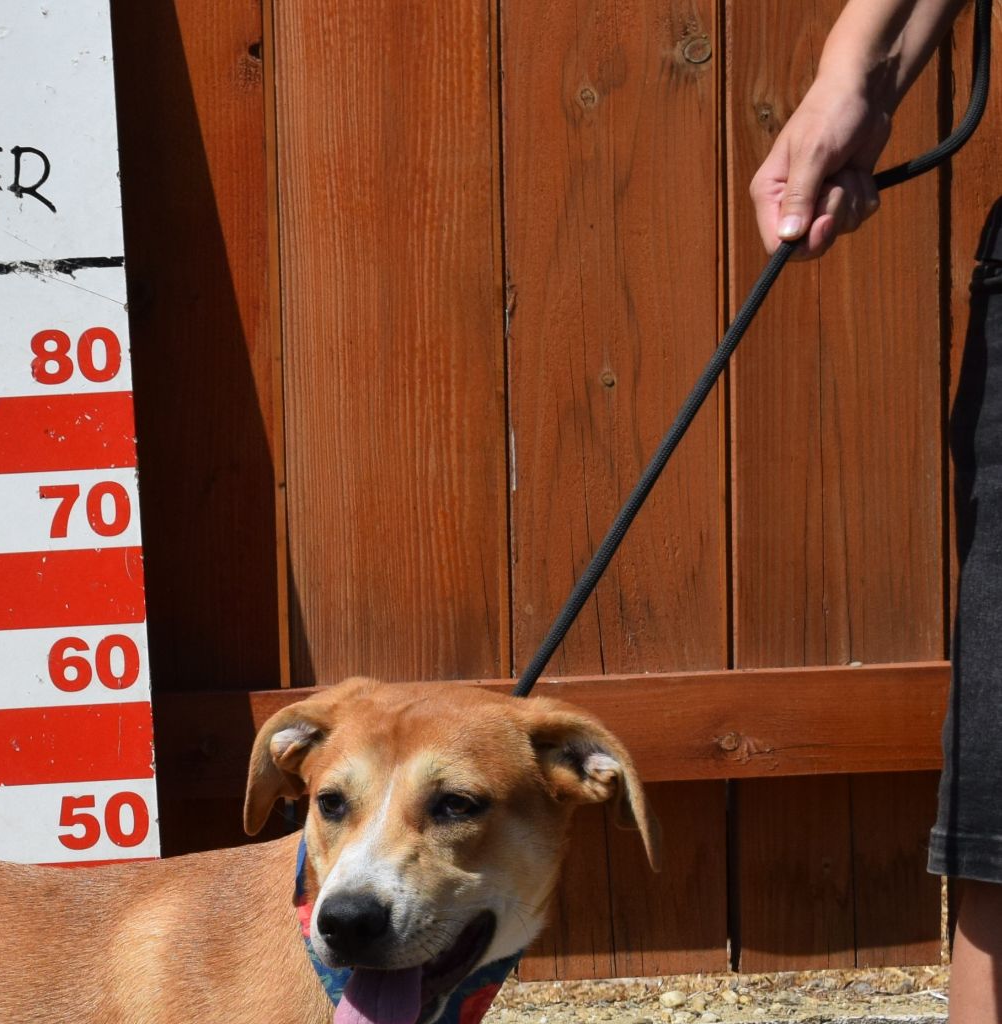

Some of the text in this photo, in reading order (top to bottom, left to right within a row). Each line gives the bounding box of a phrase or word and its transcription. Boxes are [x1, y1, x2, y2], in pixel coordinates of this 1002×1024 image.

[29, 326, 121, 386] 80
[38, 481, 131, 539] 70
[47, 633, 140, 693] 60
[57, 791, 150, 851] 50
